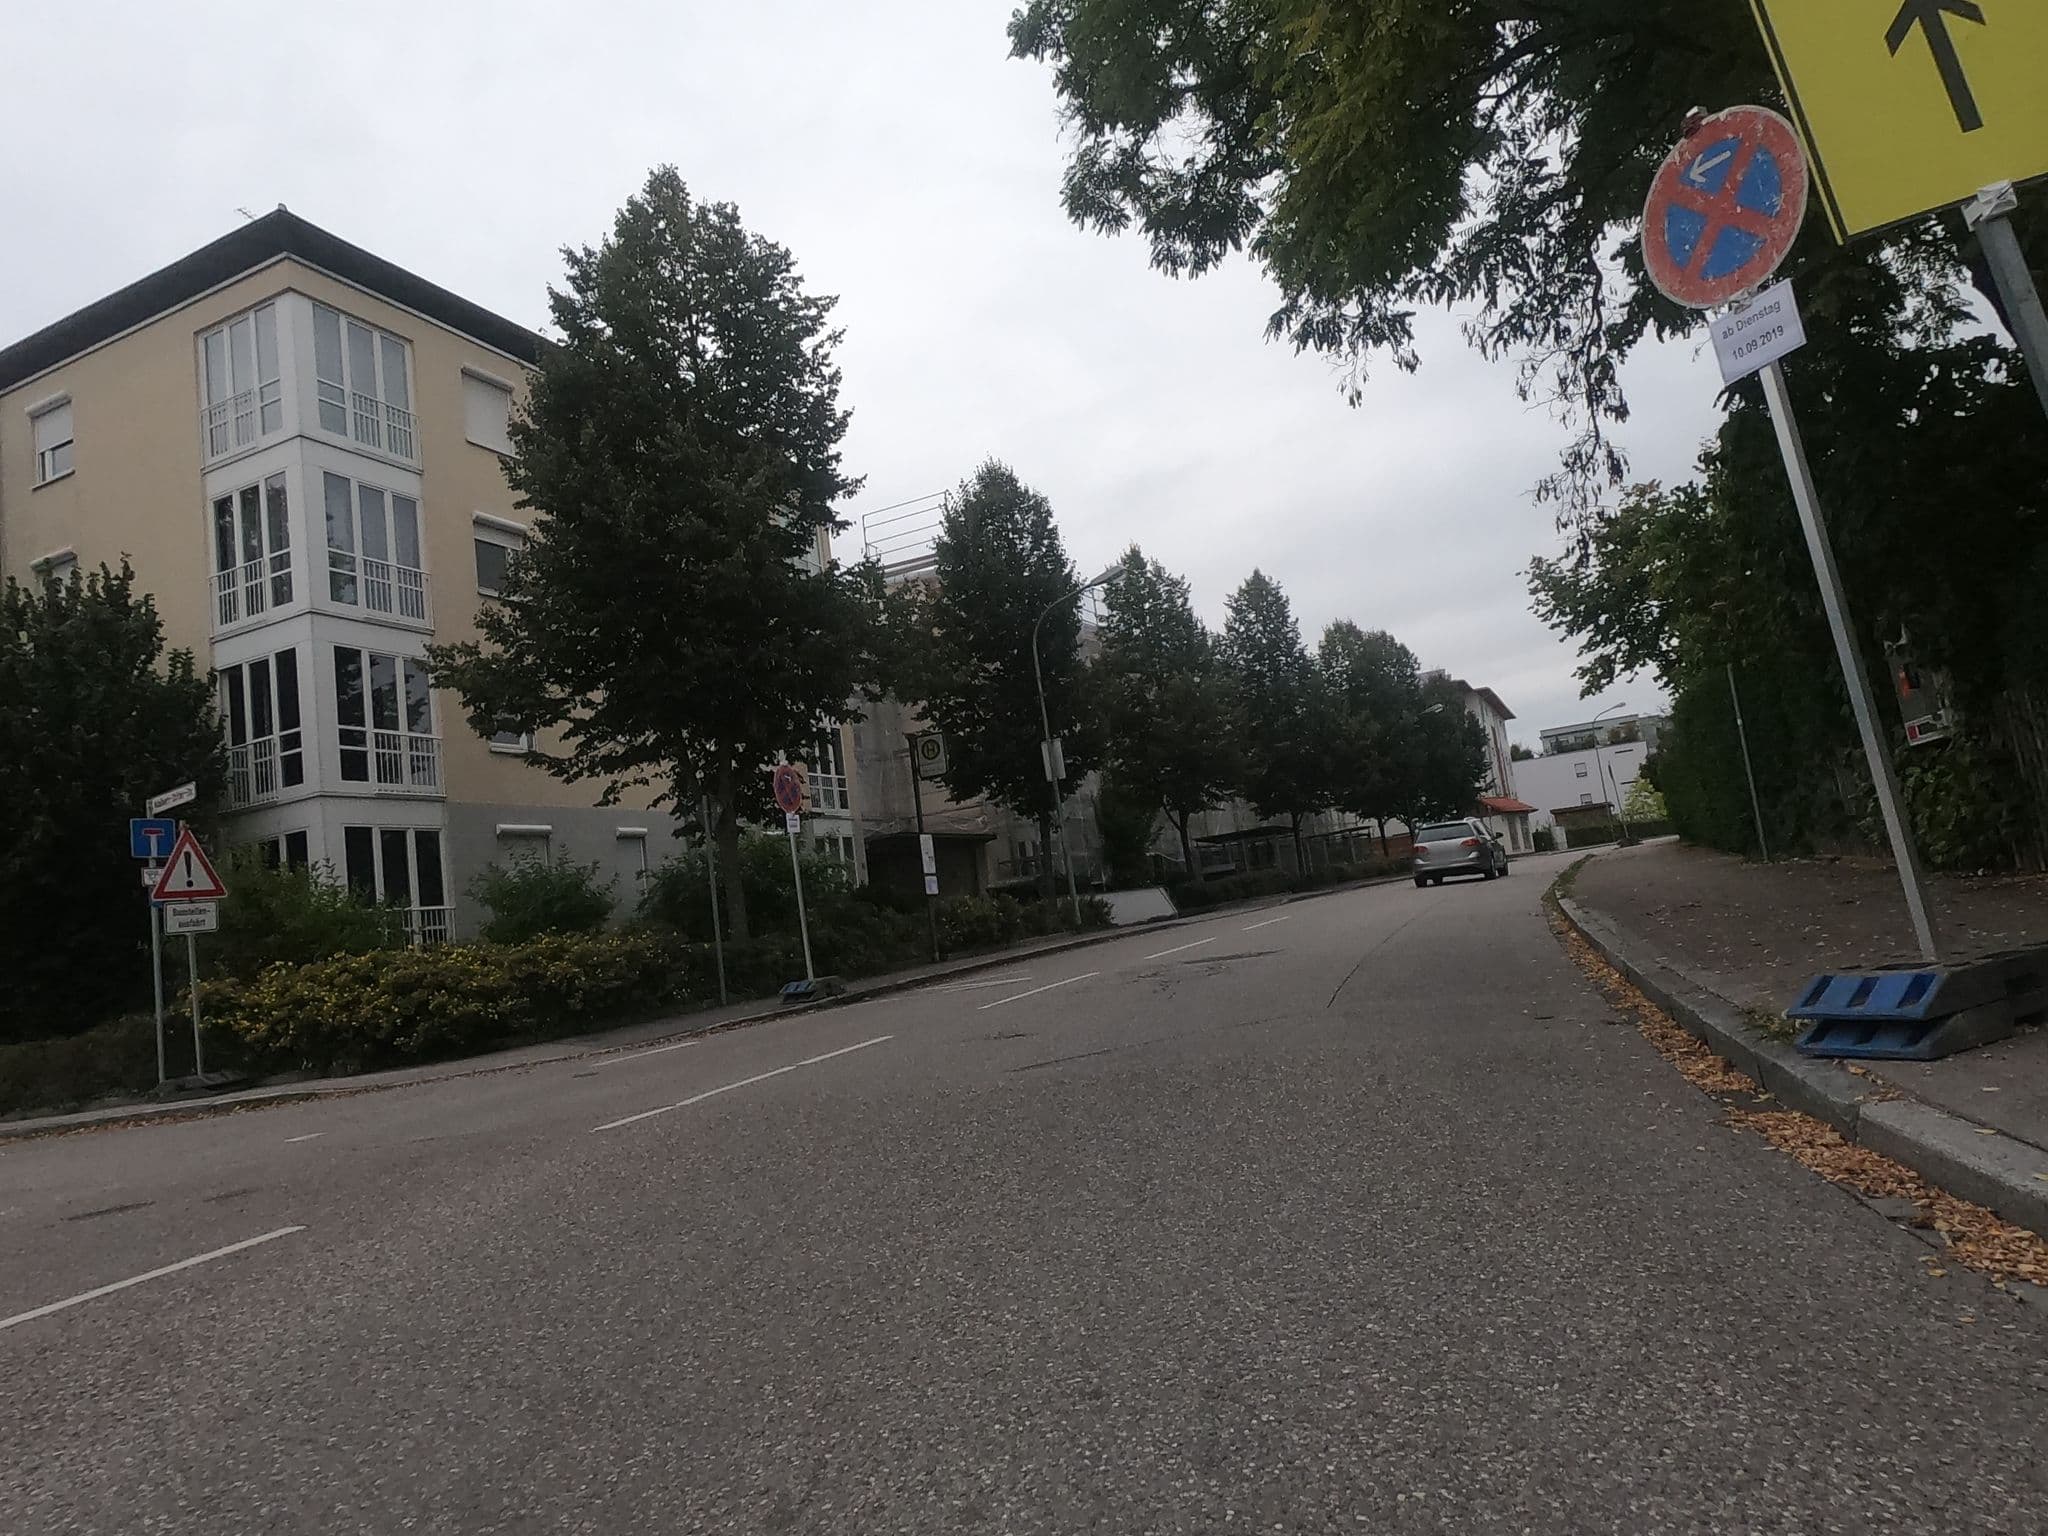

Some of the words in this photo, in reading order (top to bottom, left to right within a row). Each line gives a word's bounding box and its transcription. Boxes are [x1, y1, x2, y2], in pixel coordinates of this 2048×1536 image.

[1721, 327, 1735, 340] ab
[1735, 300, 1782, 332] Dienstag
[1732, 325, 1784, 360] 10.09.2019
